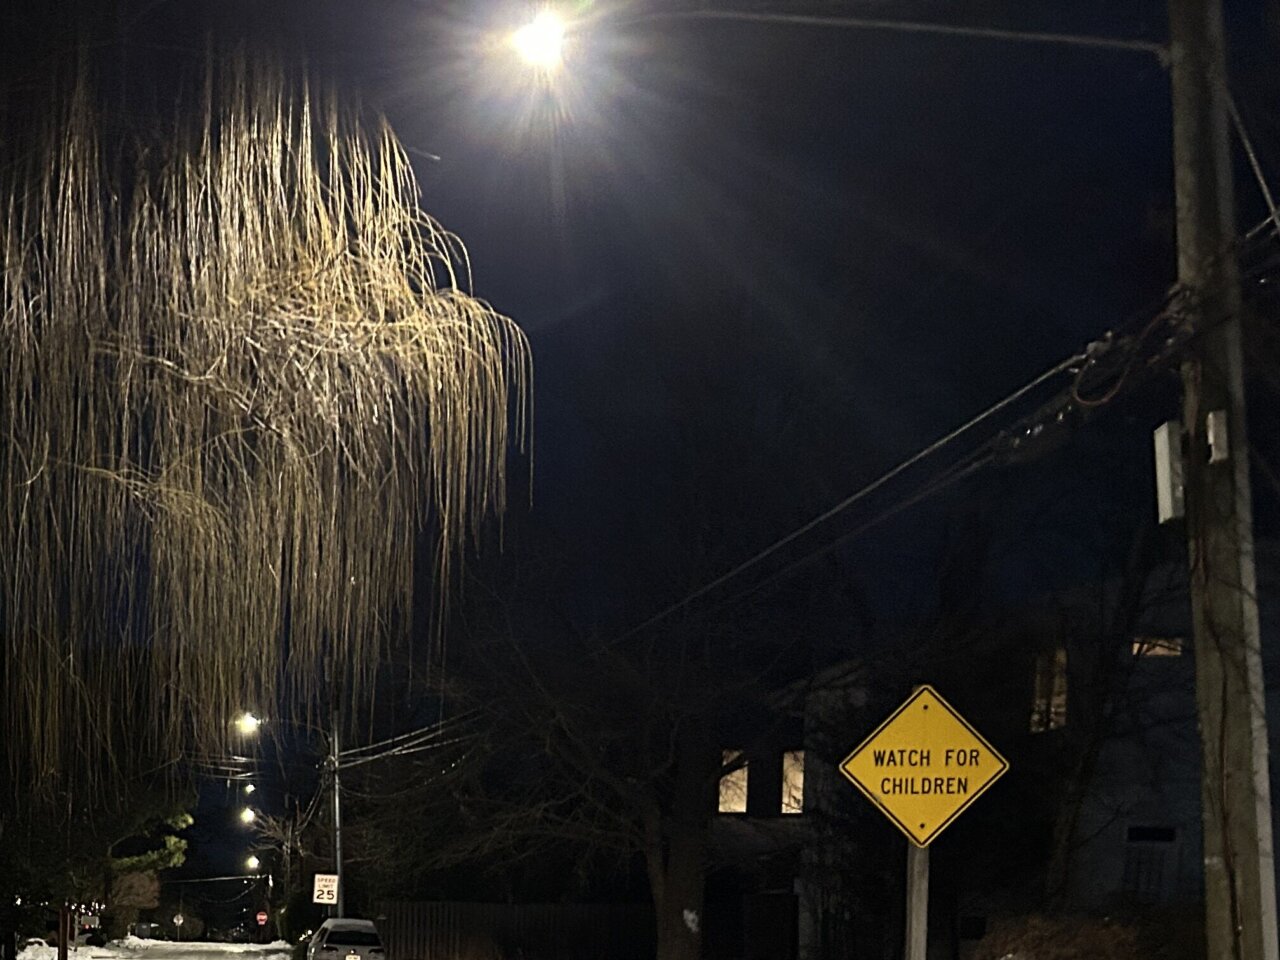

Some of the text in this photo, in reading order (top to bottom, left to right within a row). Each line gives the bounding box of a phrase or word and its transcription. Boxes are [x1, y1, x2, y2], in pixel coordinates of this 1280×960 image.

[873, 749, 980, 767] WATCH FOR
[881, 777, 968, 795] CHILDREN
[316, 889, 335, 900] 25
